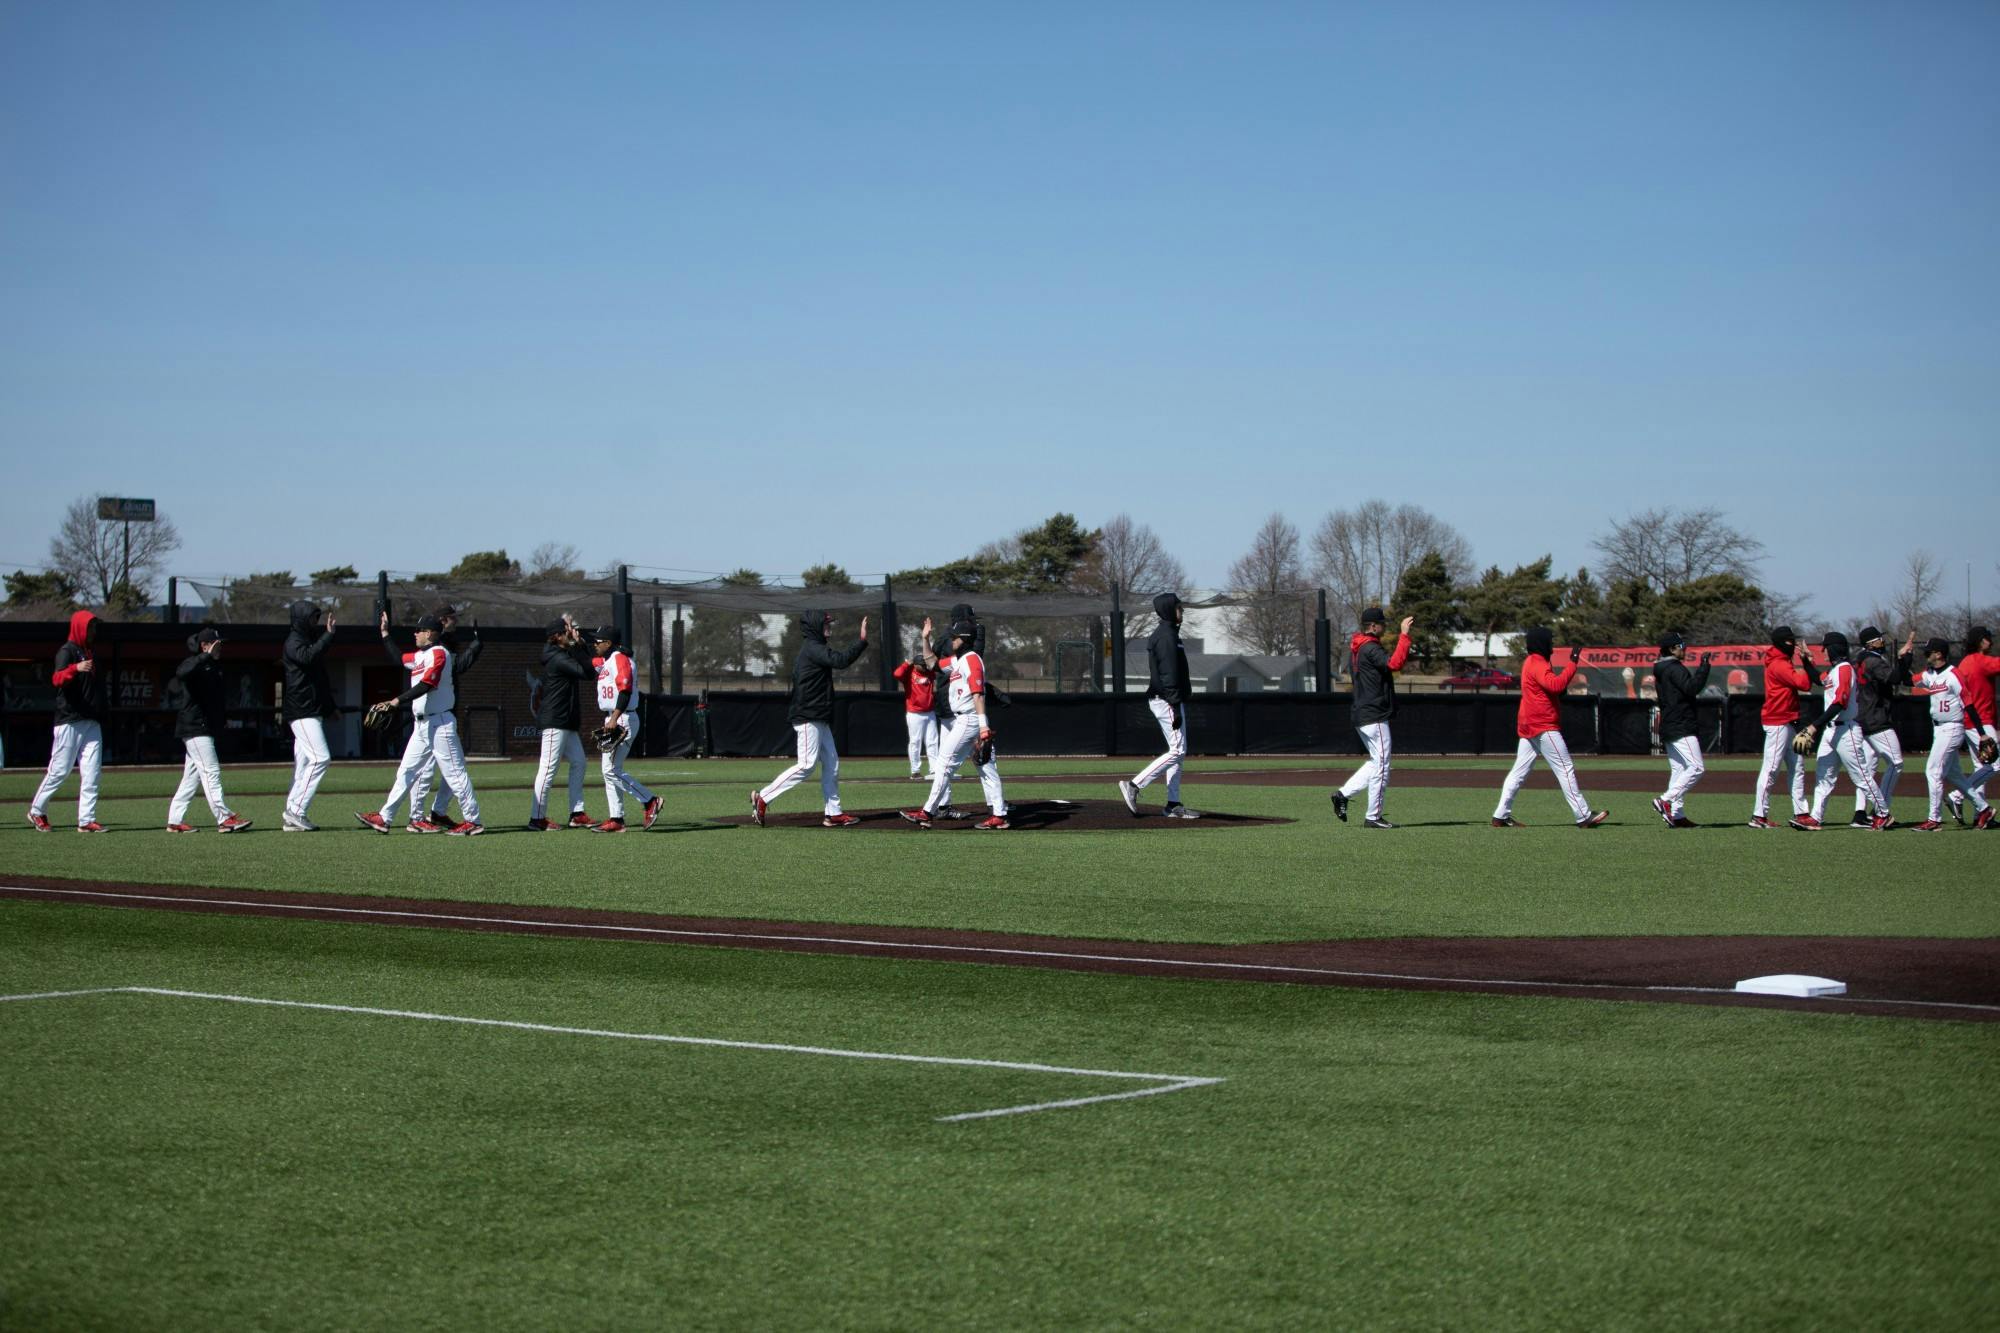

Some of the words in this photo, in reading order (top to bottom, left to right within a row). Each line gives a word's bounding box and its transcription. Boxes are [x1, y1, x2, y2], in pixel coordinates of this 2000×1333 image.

[1588, 653, 1620, 663] MAC
[1624, 652, 1697, 663] PITCS
[1724, 651, 1756, 660] THE
[602, 686, 613, 699] 38
[1939, 700, 1950, 712] 15
